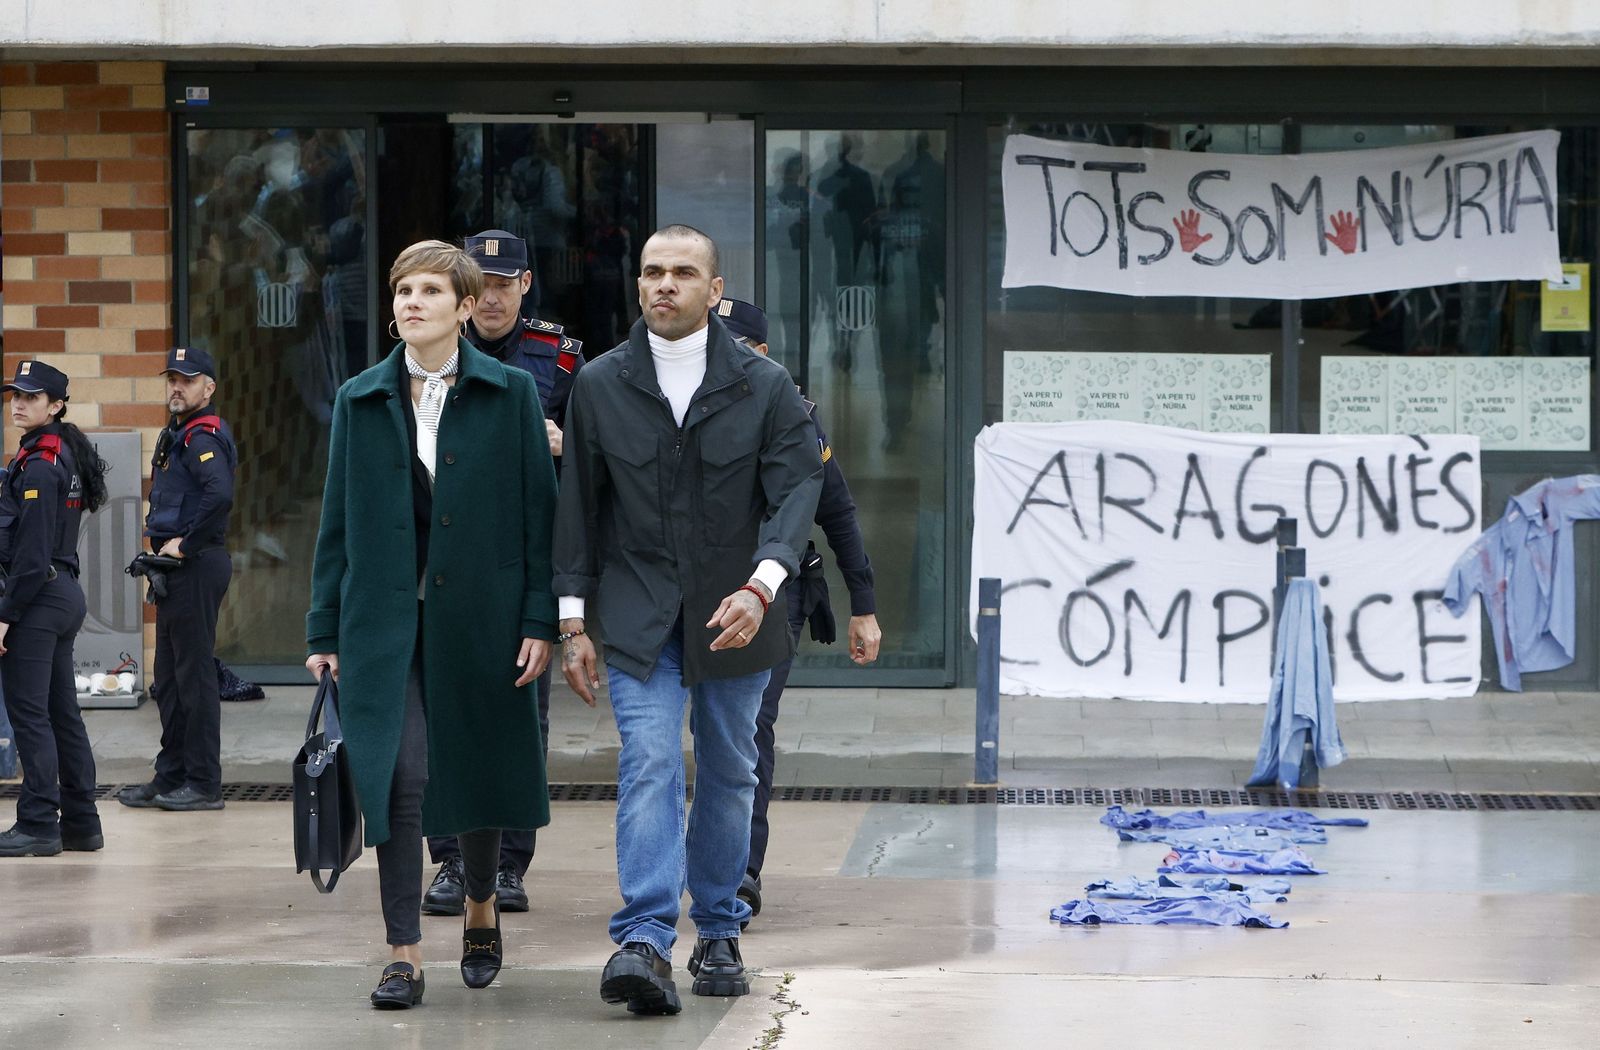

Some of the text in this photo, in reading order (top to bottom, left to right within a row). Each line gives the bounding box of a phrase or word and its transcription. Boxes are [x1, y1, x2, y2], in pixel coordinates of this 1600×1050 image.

[1357, 146, 1555, 252] NÚRIA
[1023, 391, 1034, 399] VA
[1035, 391, 1051, 399] PER
[1089, 392, 1100, 400] VA
[1102, 392, 1117, 400] PER
[1168, 393, 1184, 401] PER
[1007, 434, 1476, 543] ARAGONÈS
